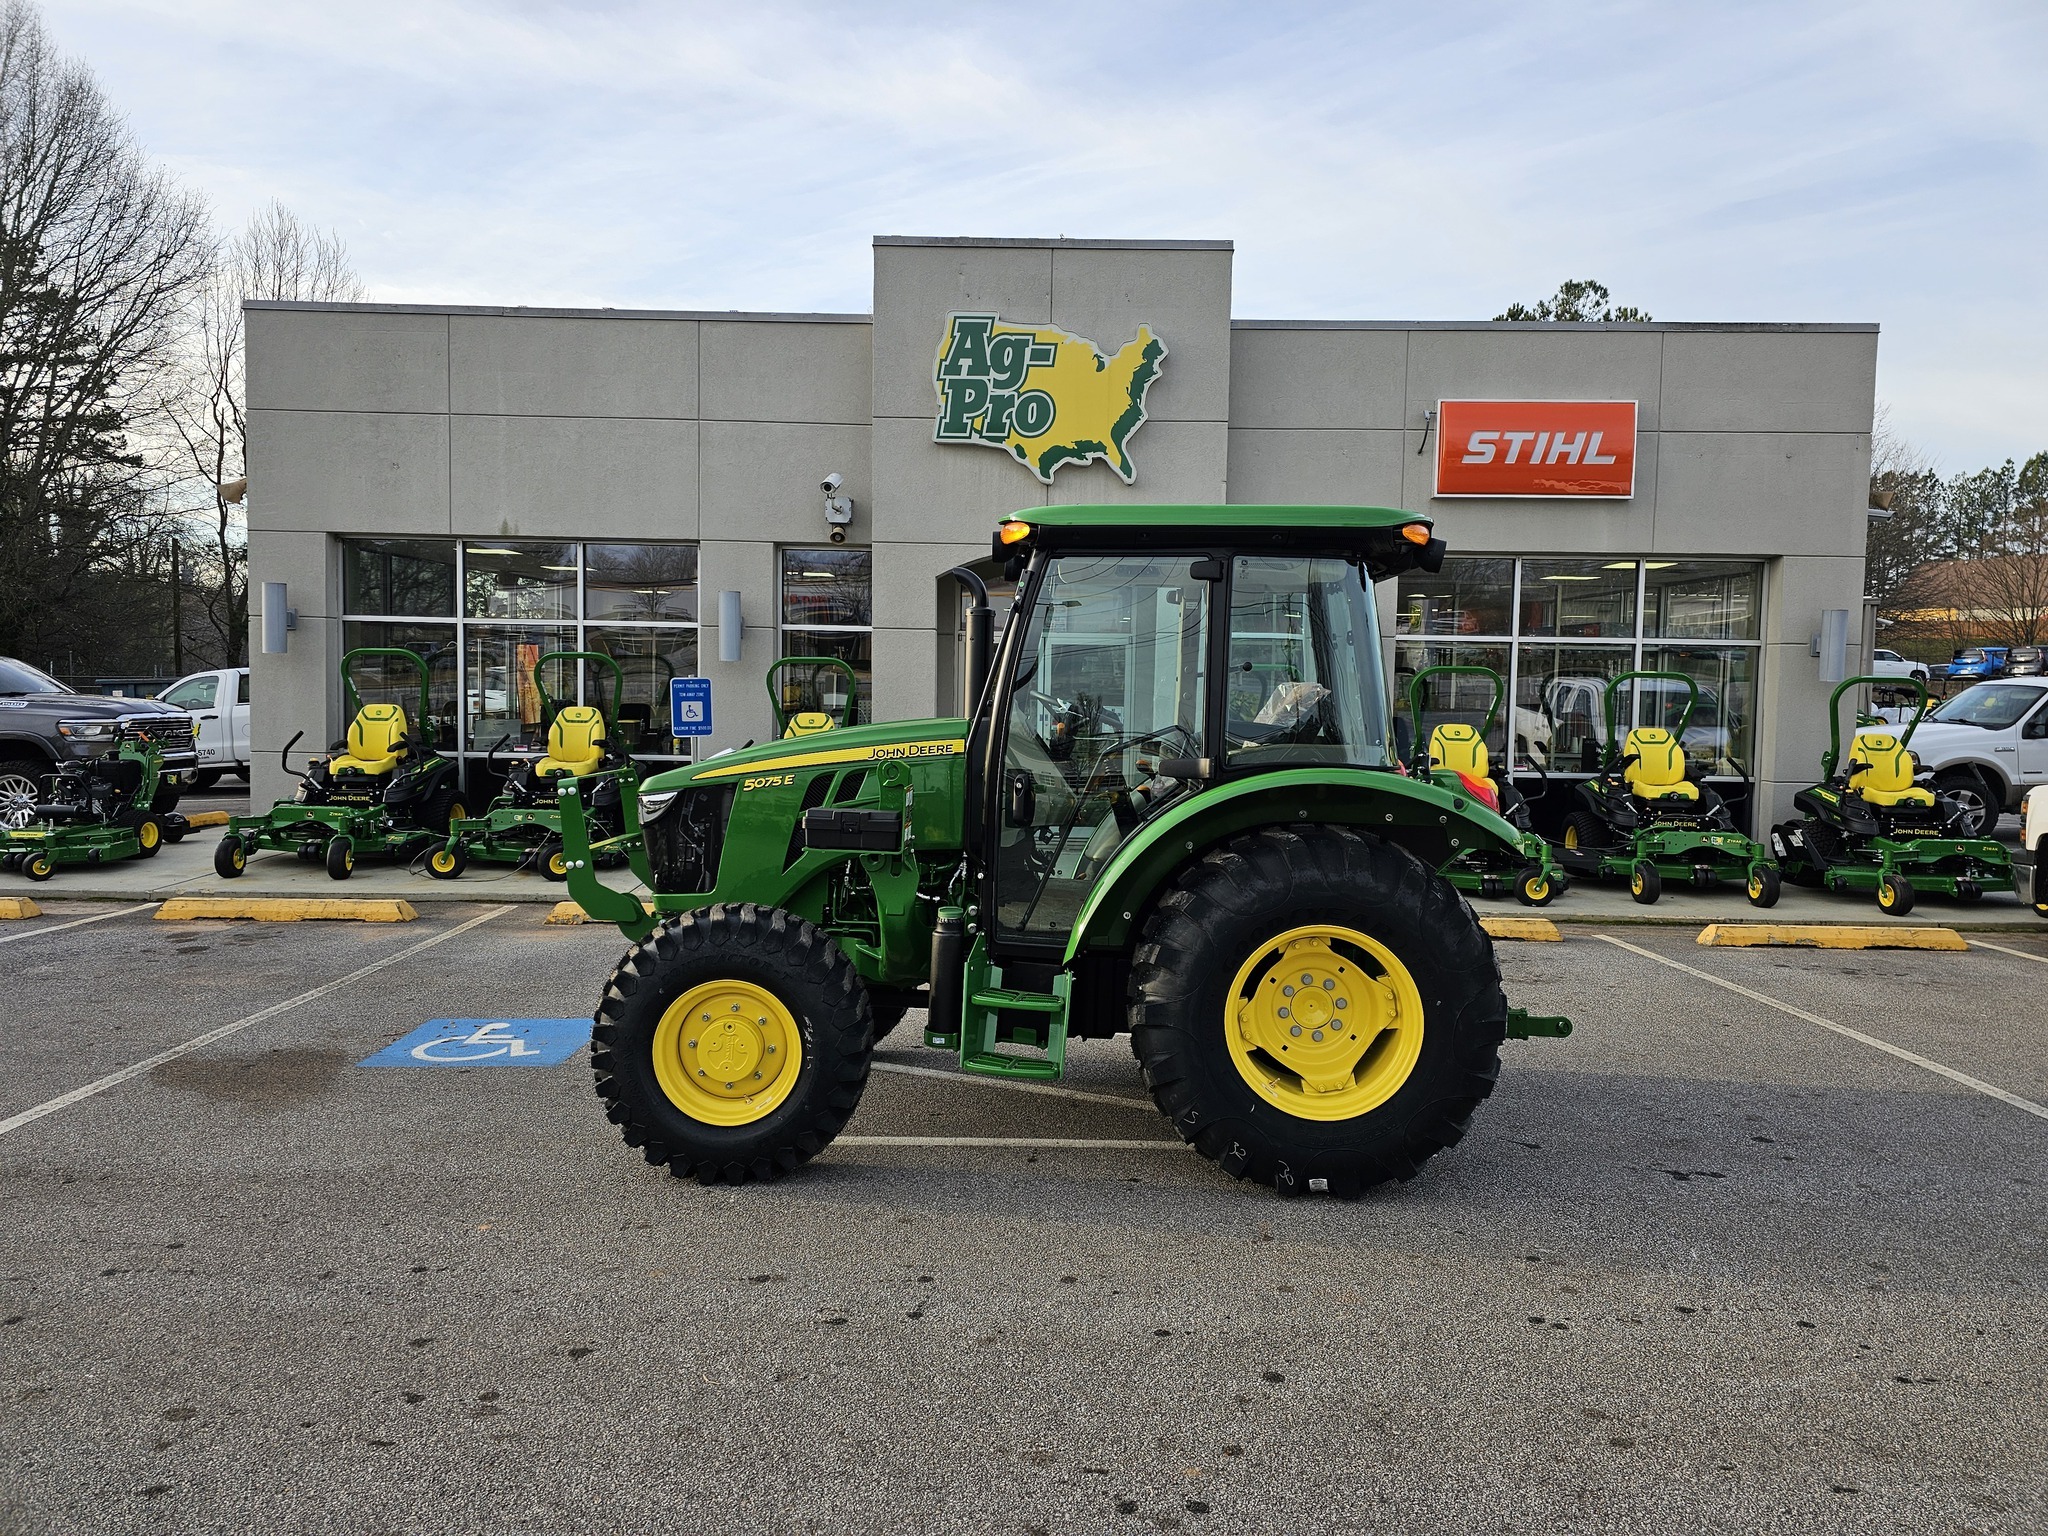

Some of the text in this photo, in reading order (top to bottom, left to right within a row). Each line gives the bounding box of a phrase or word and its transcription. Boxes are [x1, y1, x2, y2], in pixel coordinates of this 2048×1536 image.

[939, 318, 1056, 391] Ag-
[938, 378, 1056, 438] Pro
[1461, 431, 1616, 465] STIHL
[867, 744, 954, 761] JOHN DEERE
[743, 774, 795, 791] 5075 E
[1673, 820, 1698, 828] DEERE
[1914, 828, 1939, 836] DEERE
